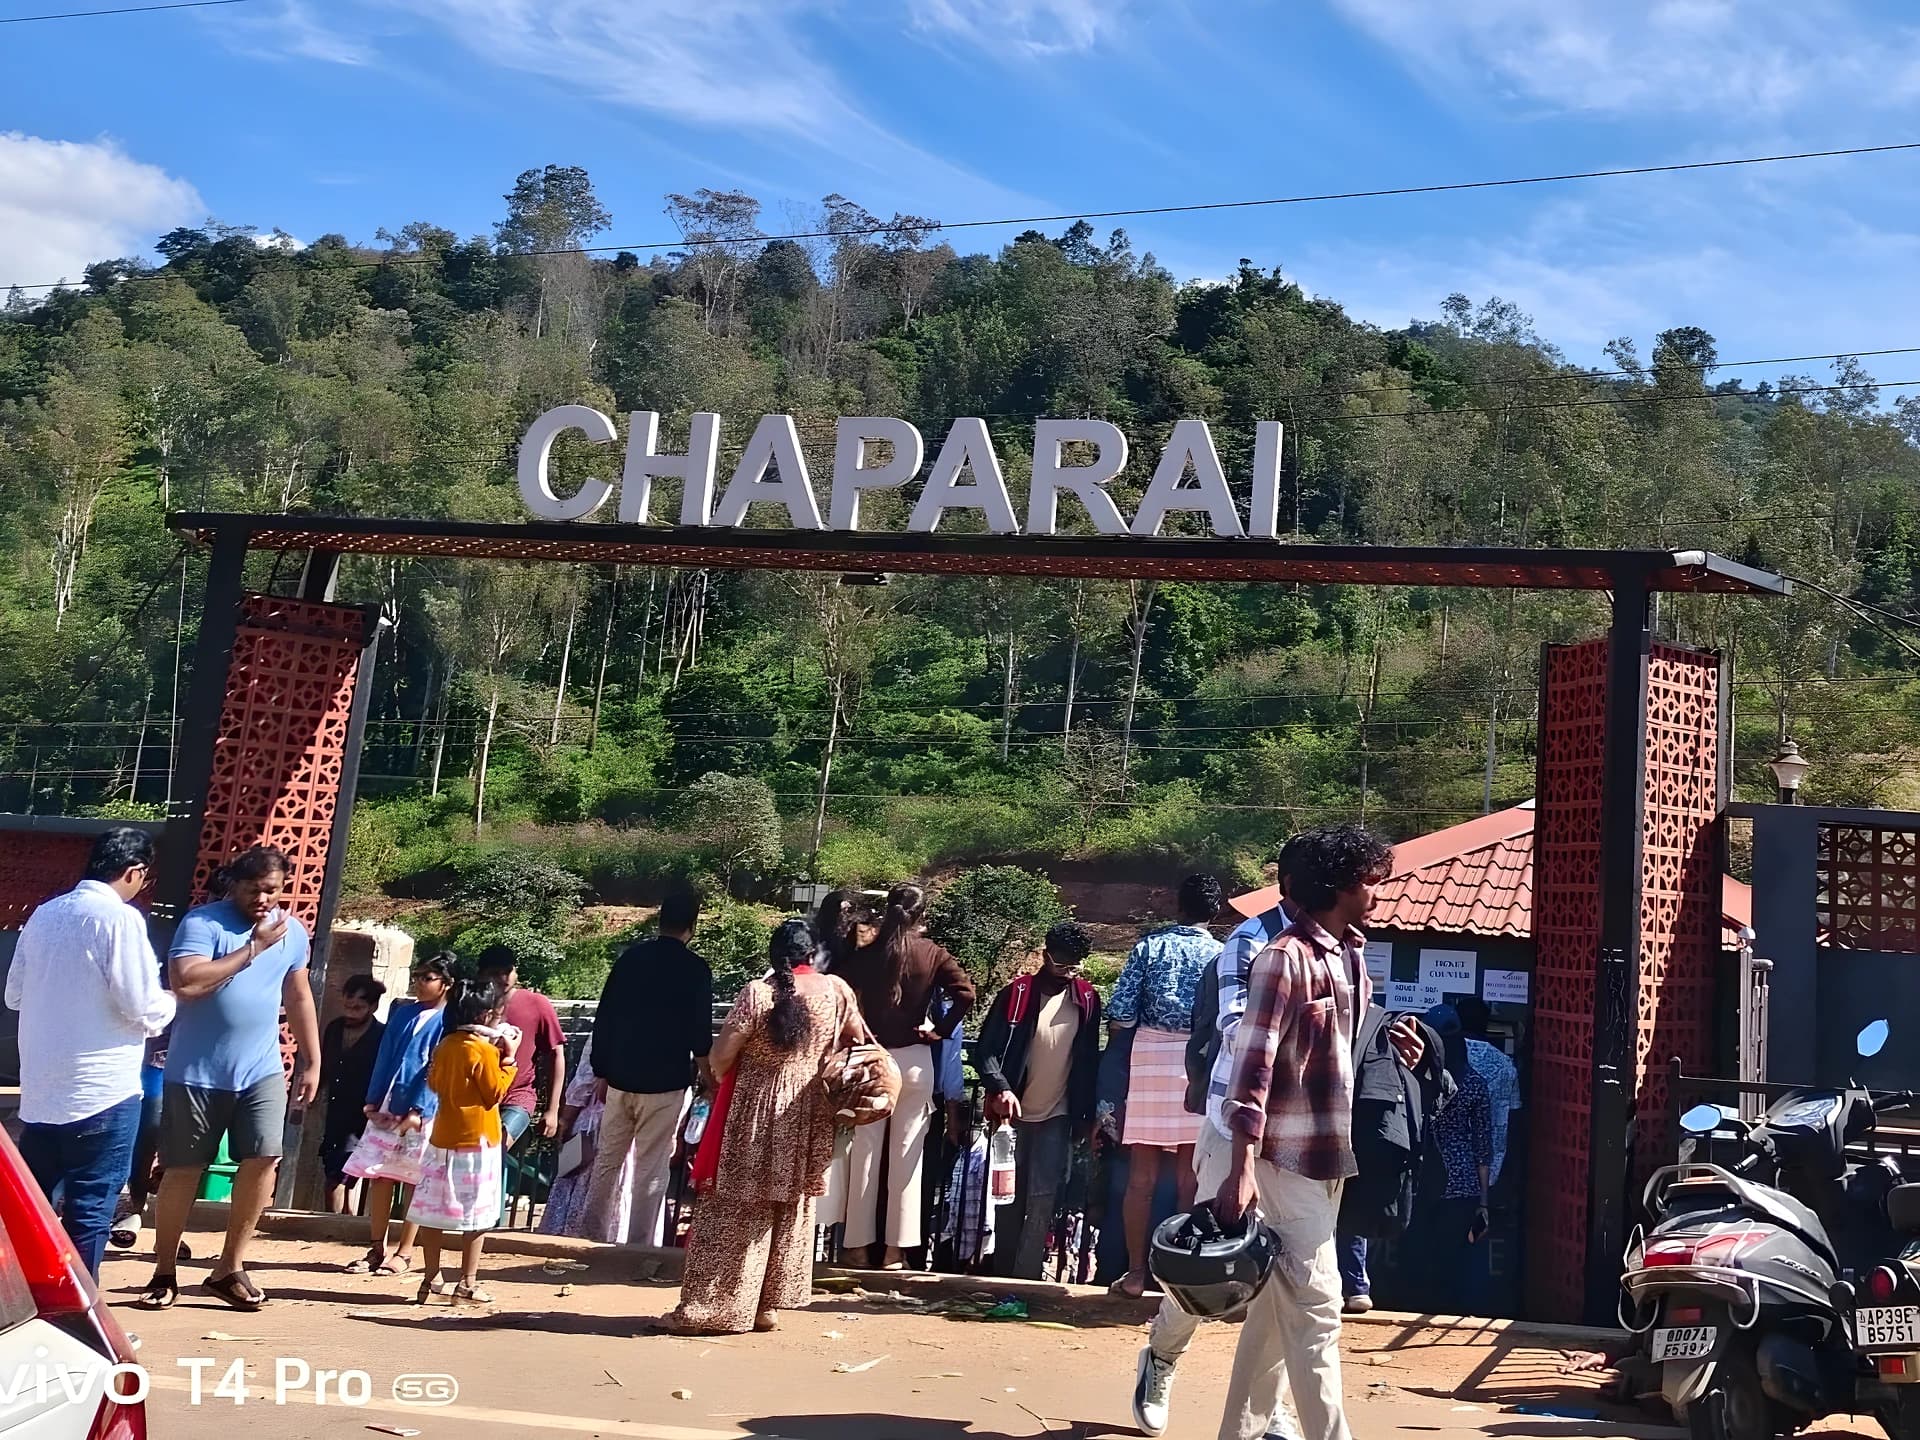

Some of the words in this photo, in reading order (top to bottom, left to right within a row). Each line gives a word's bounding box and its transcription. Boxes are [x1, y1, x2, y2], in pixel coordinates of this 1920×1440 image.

[517, 405, 1283, 540] CHAPARAI
[1867, 1307, 1914, 1325] AP39E
[1867, 1325, 1914, 1343] B5751
